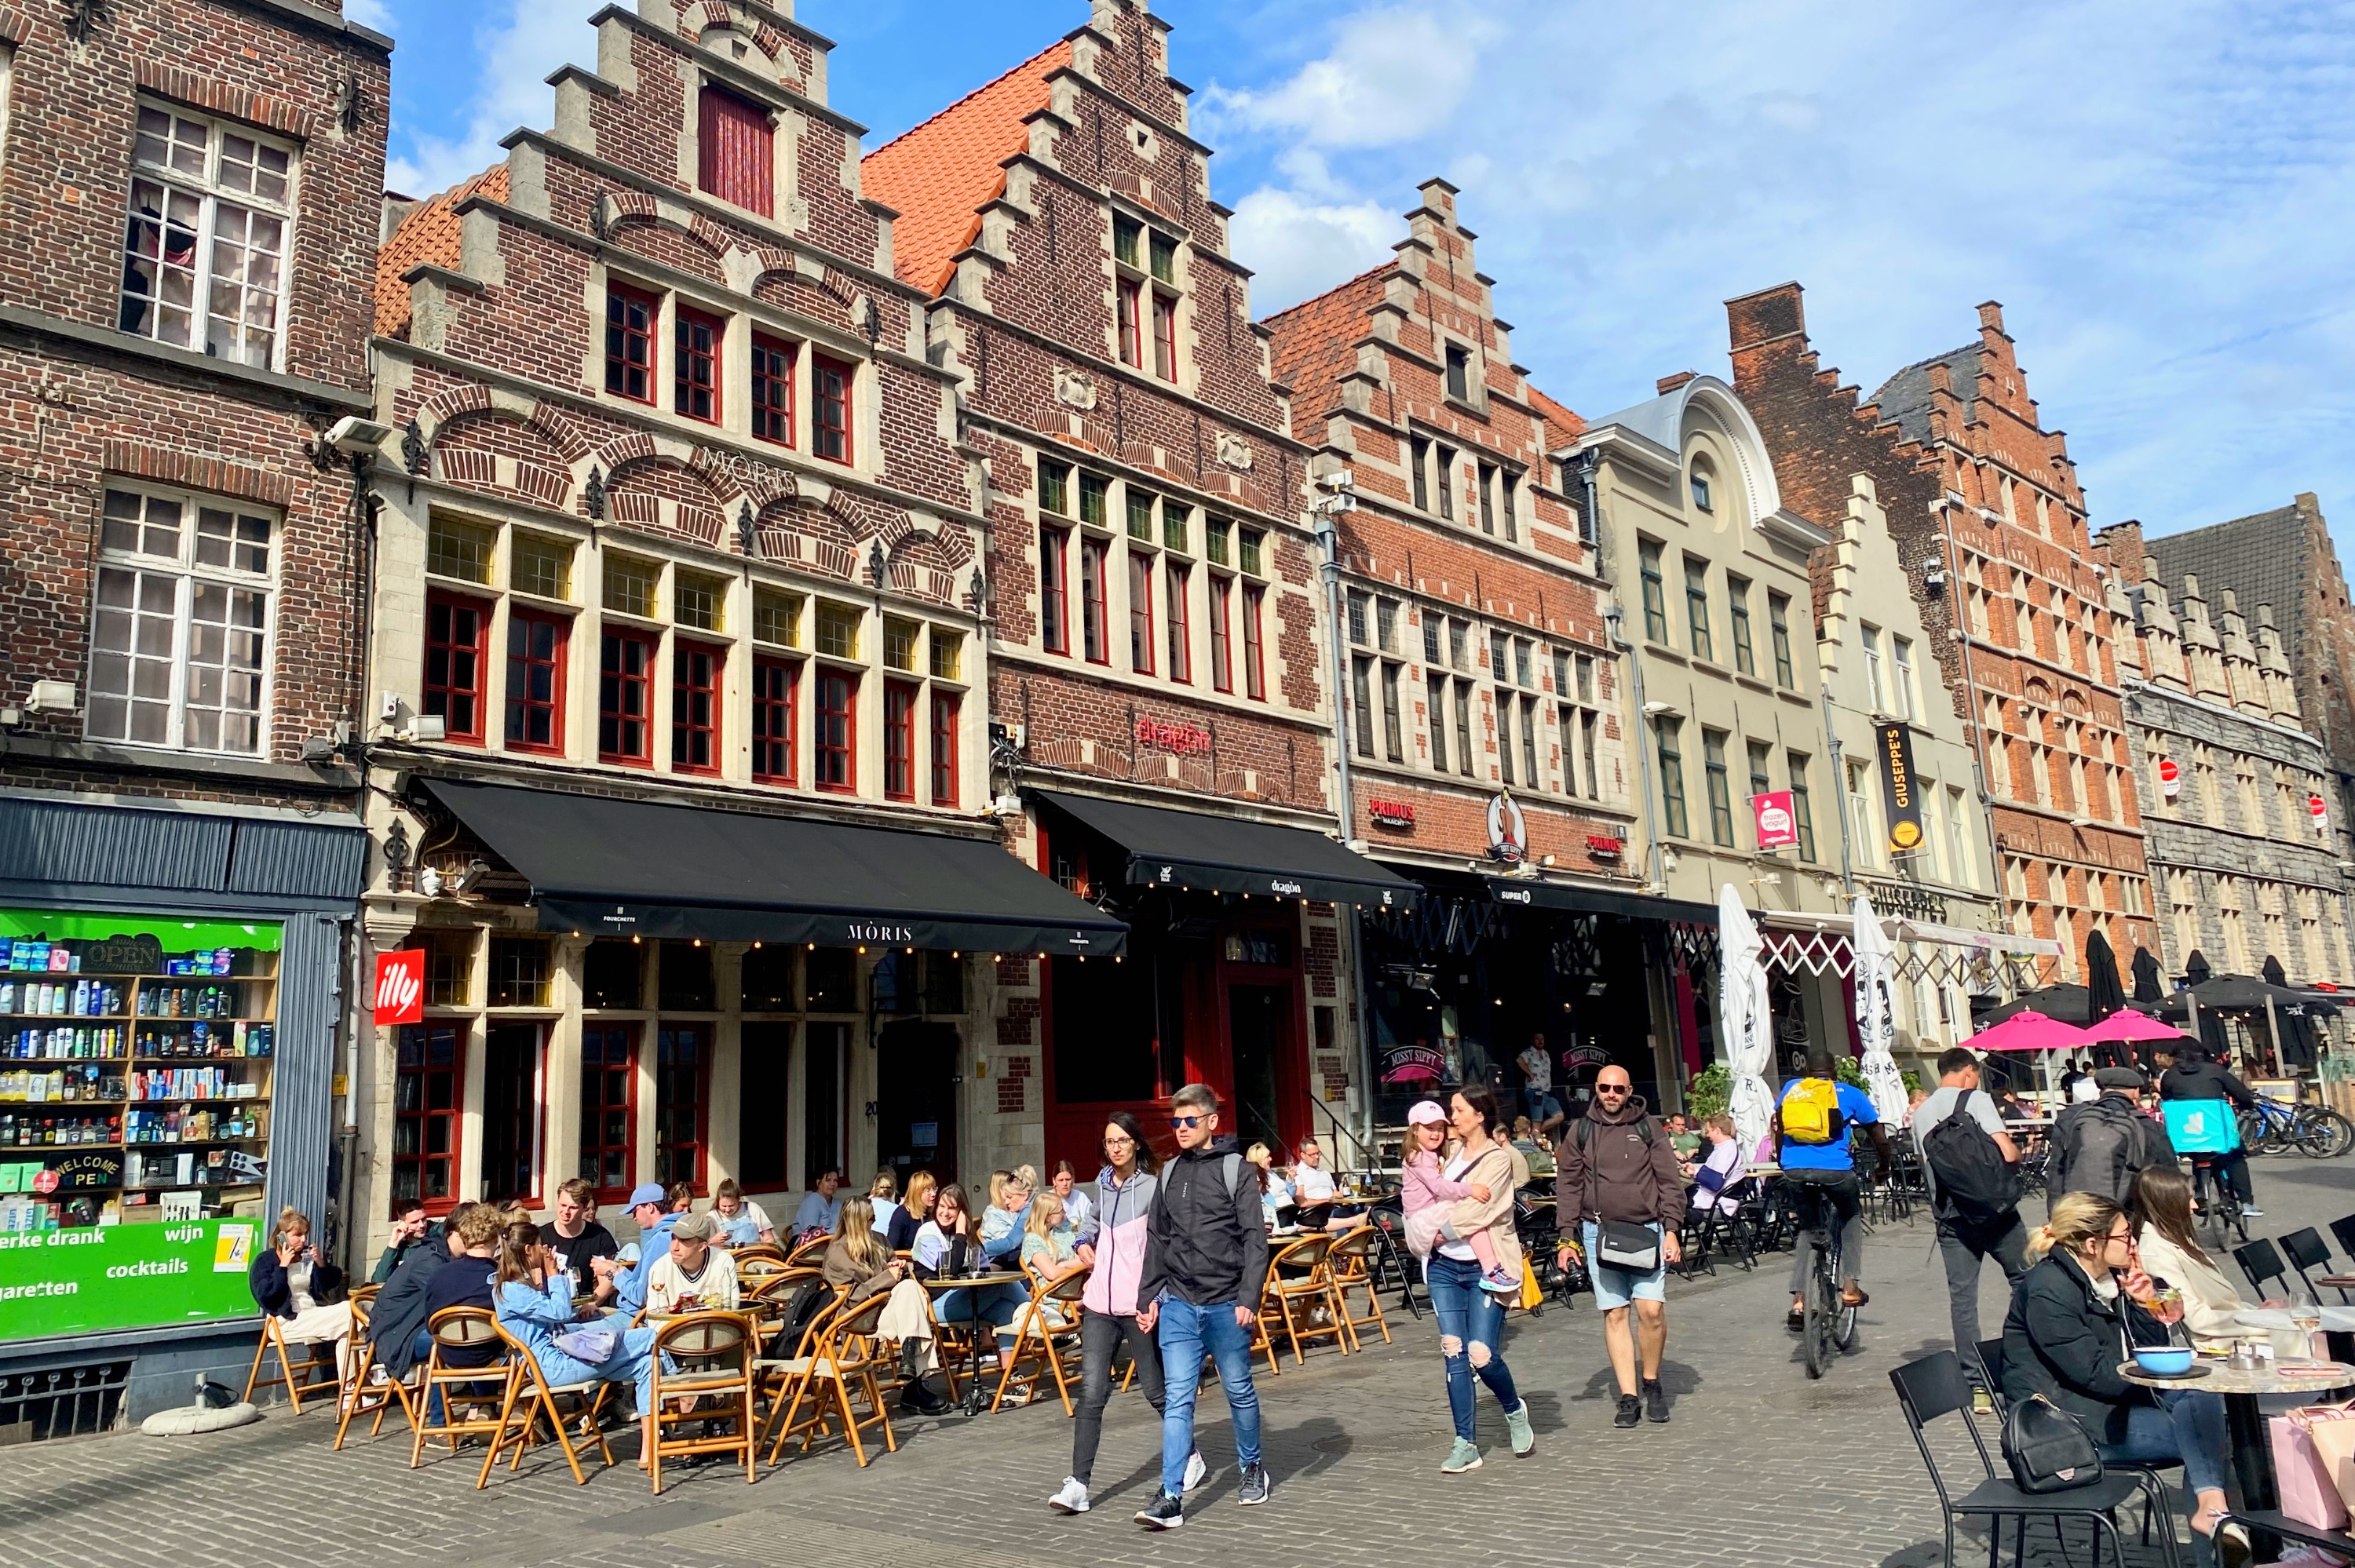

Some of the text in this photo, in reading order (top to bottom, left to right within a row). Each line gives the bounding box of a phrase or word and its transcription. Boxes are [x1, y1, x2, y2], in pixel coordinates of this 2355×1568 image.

[1887, 729, 1909, 808] GIUSEPPE'S
[1369, 800, 1415, 820] PRIMUS
[1763, 812, 1787, 821] frozen
[1382, 817, 1405, 826] HAACHT
[1764, 819, 1787, 828] yogurt
[1587, 835, 1622, 852] PRIMUS
[1271, 879, 1302, 895] dragòn
[1501, 891, 1523, 900] SUPER
[848, 921, 911, 941] MÒRIS
[89, 945, 156, 965] OPEN
[377, 962, 420, 1017] illy
[1391, 1049, 1437, 1067] MISSY SIPPY
[55, 1156, 119, 1177] WELCOME
[64, 1172, 108, 1186] OPEN
[47, 1228, 105, 1246] drank
[164, 1225, 203, 1245] wijn
[107, 1258, 188, 1279] cocktails
